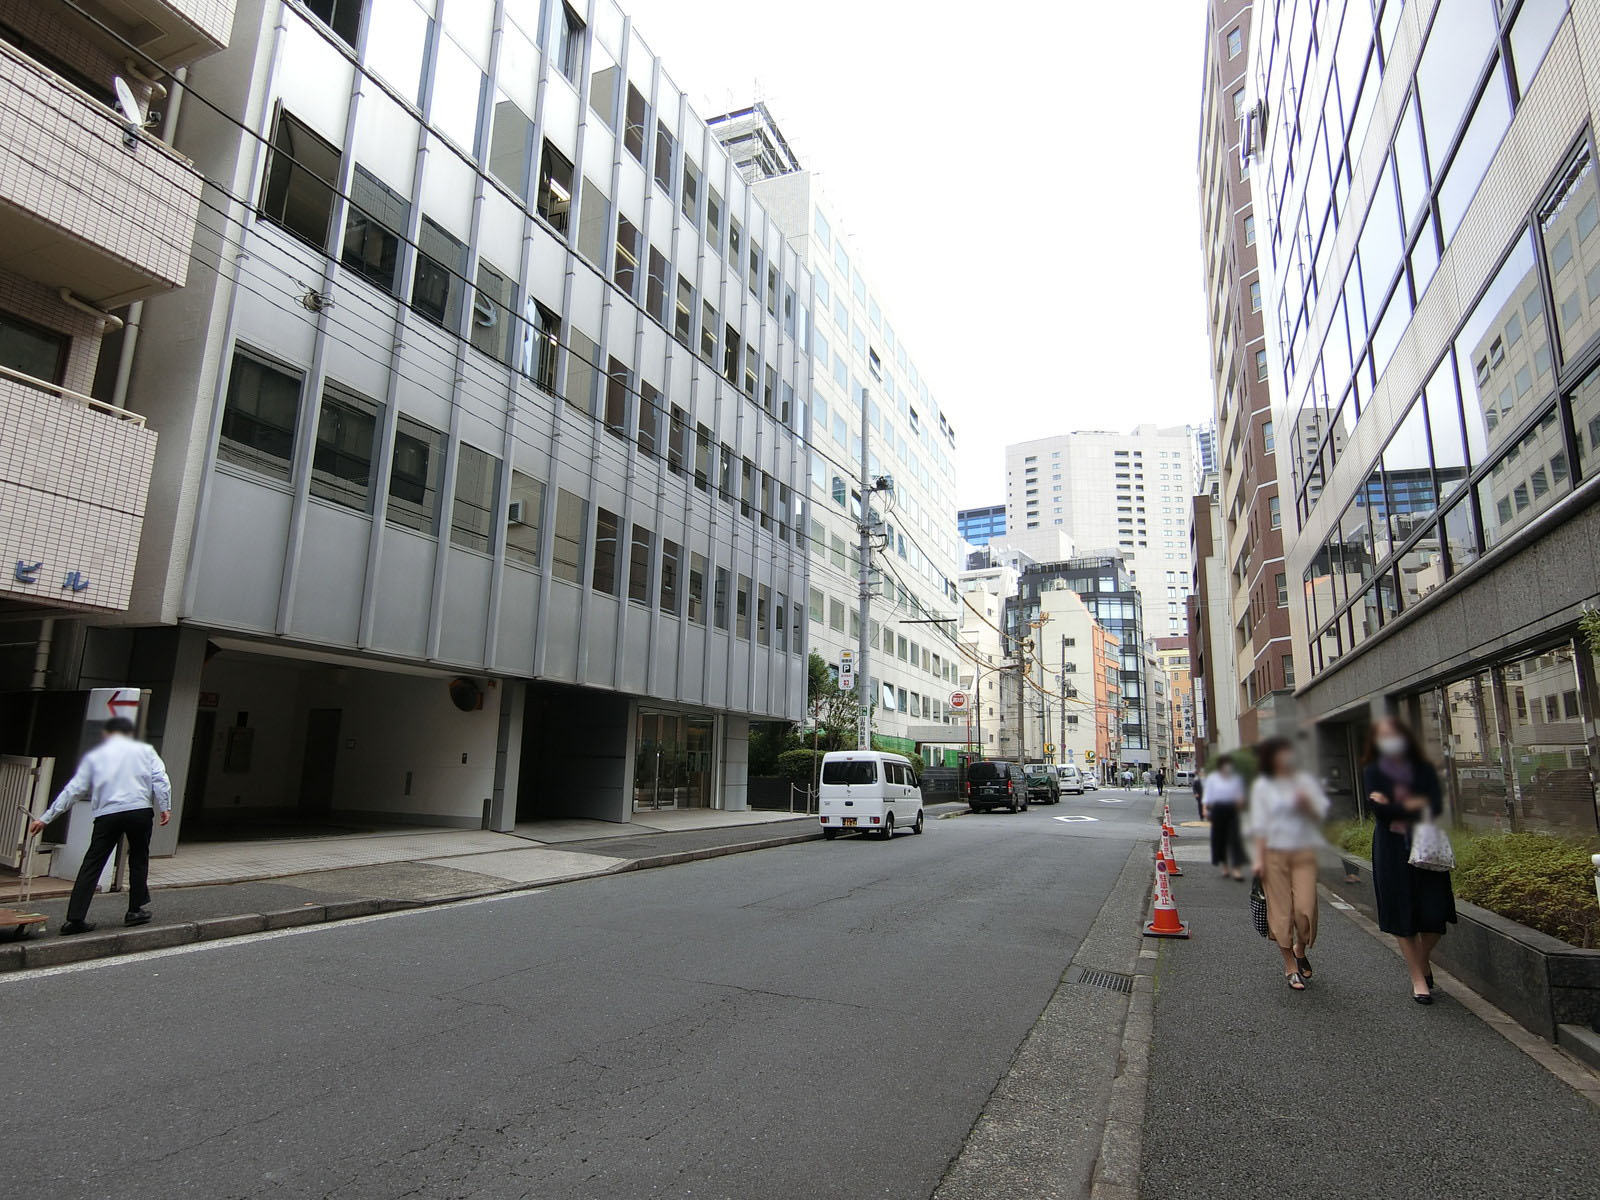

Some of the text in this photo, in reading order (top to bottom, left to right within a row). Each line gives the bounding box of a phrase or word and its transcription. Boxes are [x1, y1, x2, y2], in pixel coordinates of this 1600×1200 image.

[15, 560, 90, 592] ビル
[1159, 874, 1170, 905] 駐車禁止
